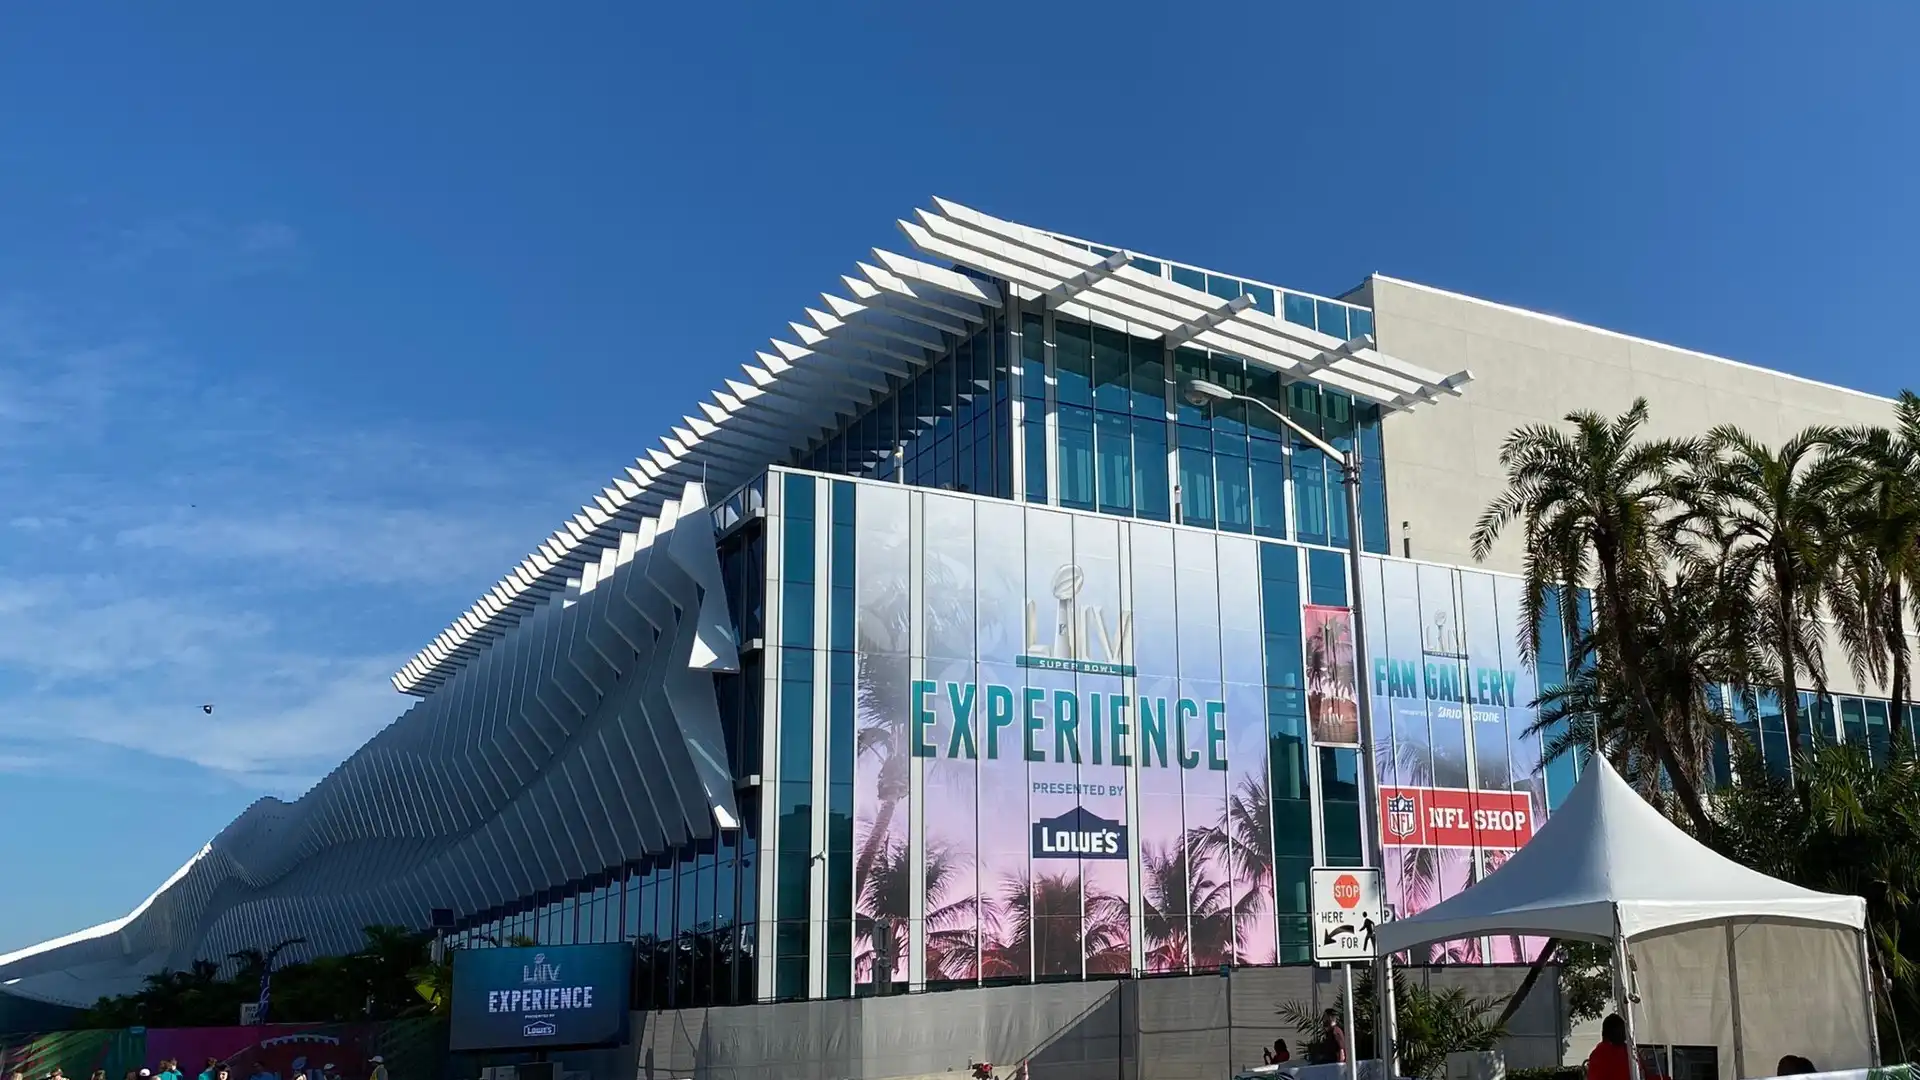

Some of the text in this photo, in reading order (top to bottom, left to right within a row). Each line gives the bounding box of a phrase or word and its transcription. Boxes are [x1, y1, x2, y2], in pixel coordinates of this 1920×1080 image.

[1039, 659, 1116, 673] SUPER BOWL
[1374, 657, 1516, 708] FAN GALLERY
[911, 679, 1229, 772] EXPERIENCE
[1032, 782, 1124, 797] PRESENTED BY
[1389, 811, 1415, 830] NFL
[1428, 806, 1526, 832] NFL SHOP
[1042, 826, 1120, 854] LOWE'S
[1335, 885, 1359, 898] STOP
[1321, 911, 1344, 924] HERE
[1341, 937, 1359, 949] FOR
[488, 986, 593, 1013] EXPERIENCE
